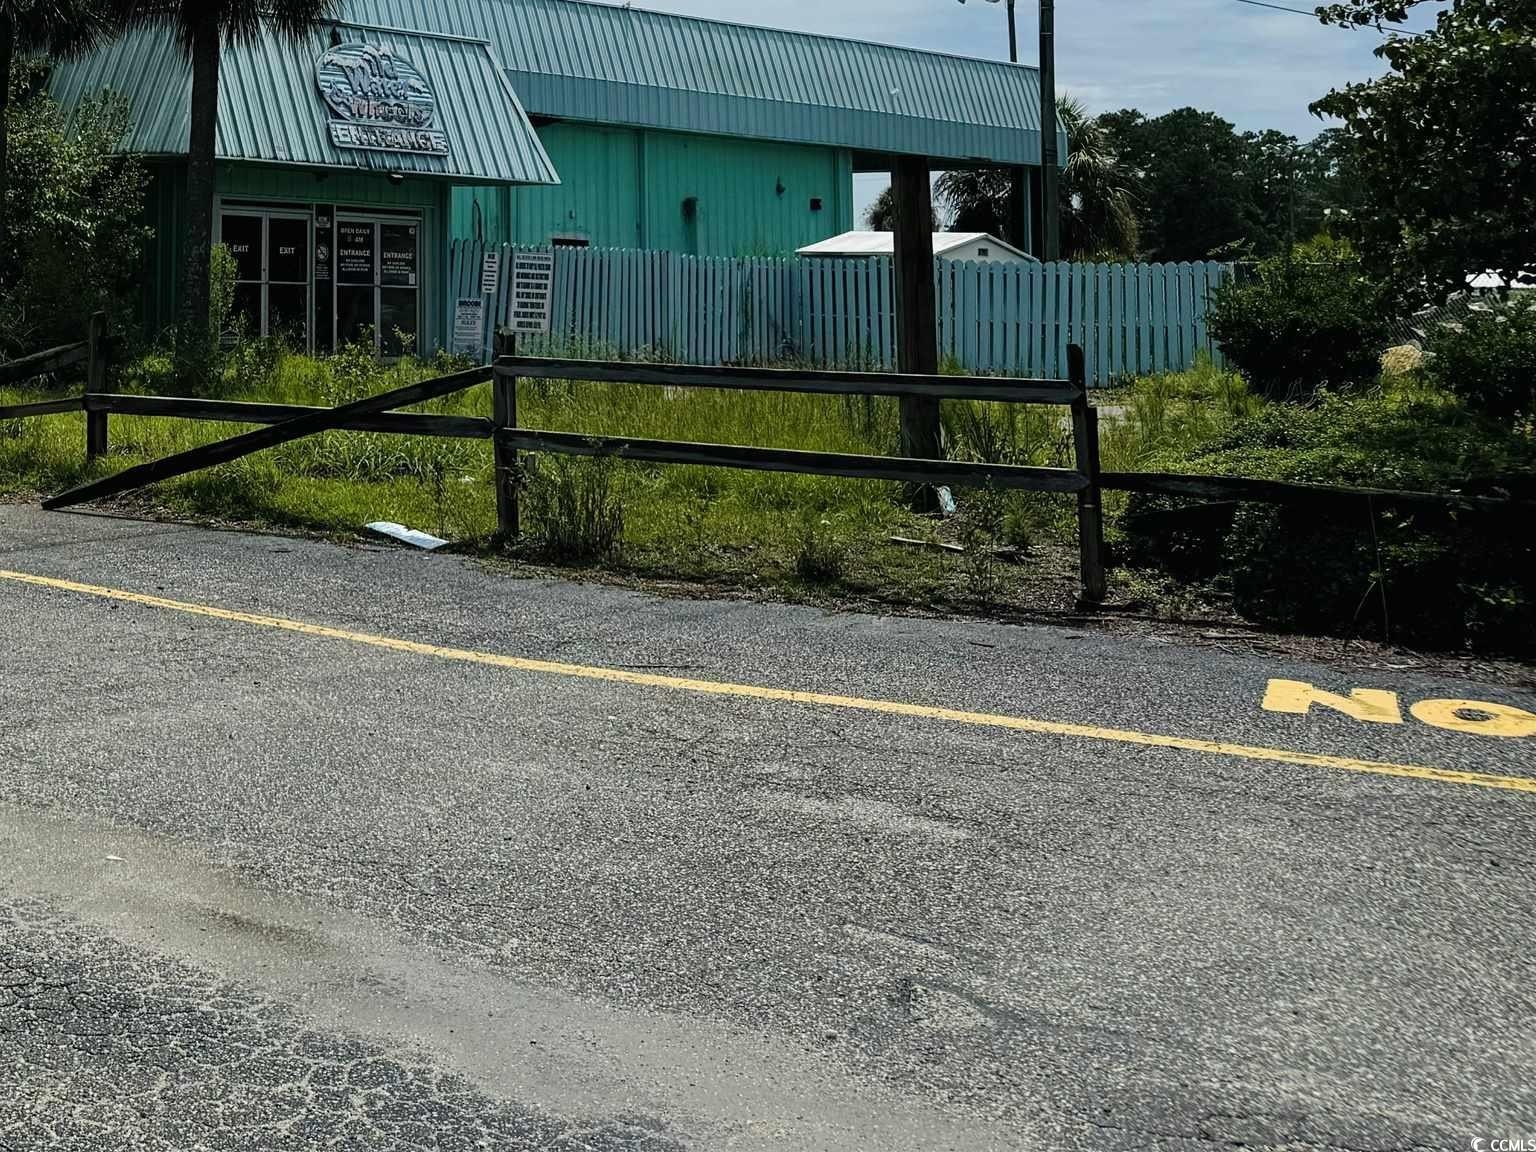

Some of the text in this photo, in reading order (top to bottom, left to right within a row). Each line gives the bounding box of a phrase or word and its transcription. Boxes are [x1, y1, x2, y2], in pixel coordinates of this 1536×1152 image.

[350, 98, 426, 127] Wheels
[334, 125, 448, 152] ENTRANCE
[233, 244, 249, 253] EXIT
[279, 246, 295, 255] EXIT
[340, 249, 371, 257] ENTRANCE
[383, 251, 413, 260] ENTRANCE
[1261, 678, 1536, 737] NO
